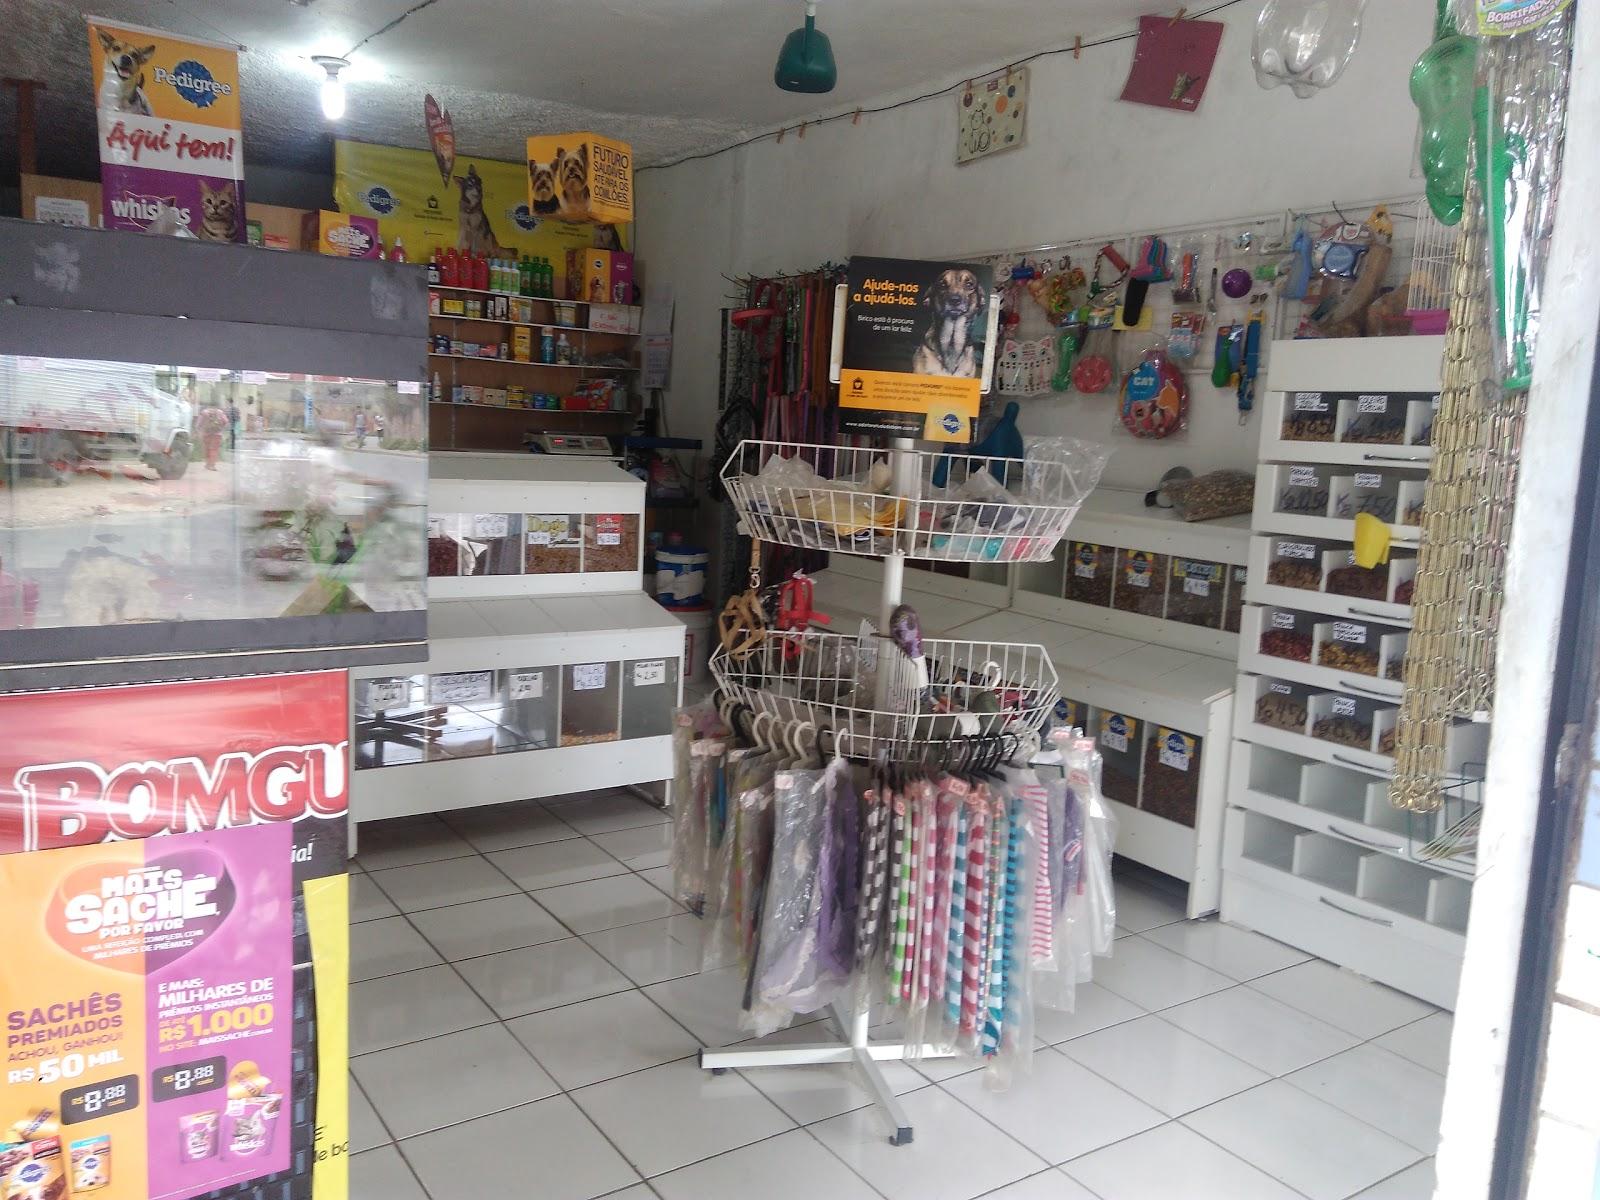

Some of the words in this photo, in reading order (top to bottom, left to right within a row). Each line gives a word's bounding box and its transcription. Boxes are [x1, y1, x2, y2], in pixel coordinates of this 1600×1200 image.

[153, 65, 232, 97] Pedigree
[106, 118, 171, 161] Aqui
[176, 131, 236, 161] tem!
[593, 146, 629, 169] FUTURO
[853, 292, 862, 303] a
[863, 291, 918, 307] ajudá-los.
[862, 278, 920, 294] Ajude-nos
[101, 924, 131, 939] POR
[133, 917, 184, 933] FAVOR
[158, 982, 167, 993] E
[158, 982, 248, 1008] MILHARES
[250, 977, 274, 993] DE
[7, 992, 123, 1031] SACHÊS
[158, 1004, 202, 1019] PRÊMIOS
[187, 1003, 274, 1038] 1.000
[7, 1015, 123, 1048] PREMIADOS
[38, 1053, 85, 1085] 50
[88, 1049, 124, 1068] MIL
